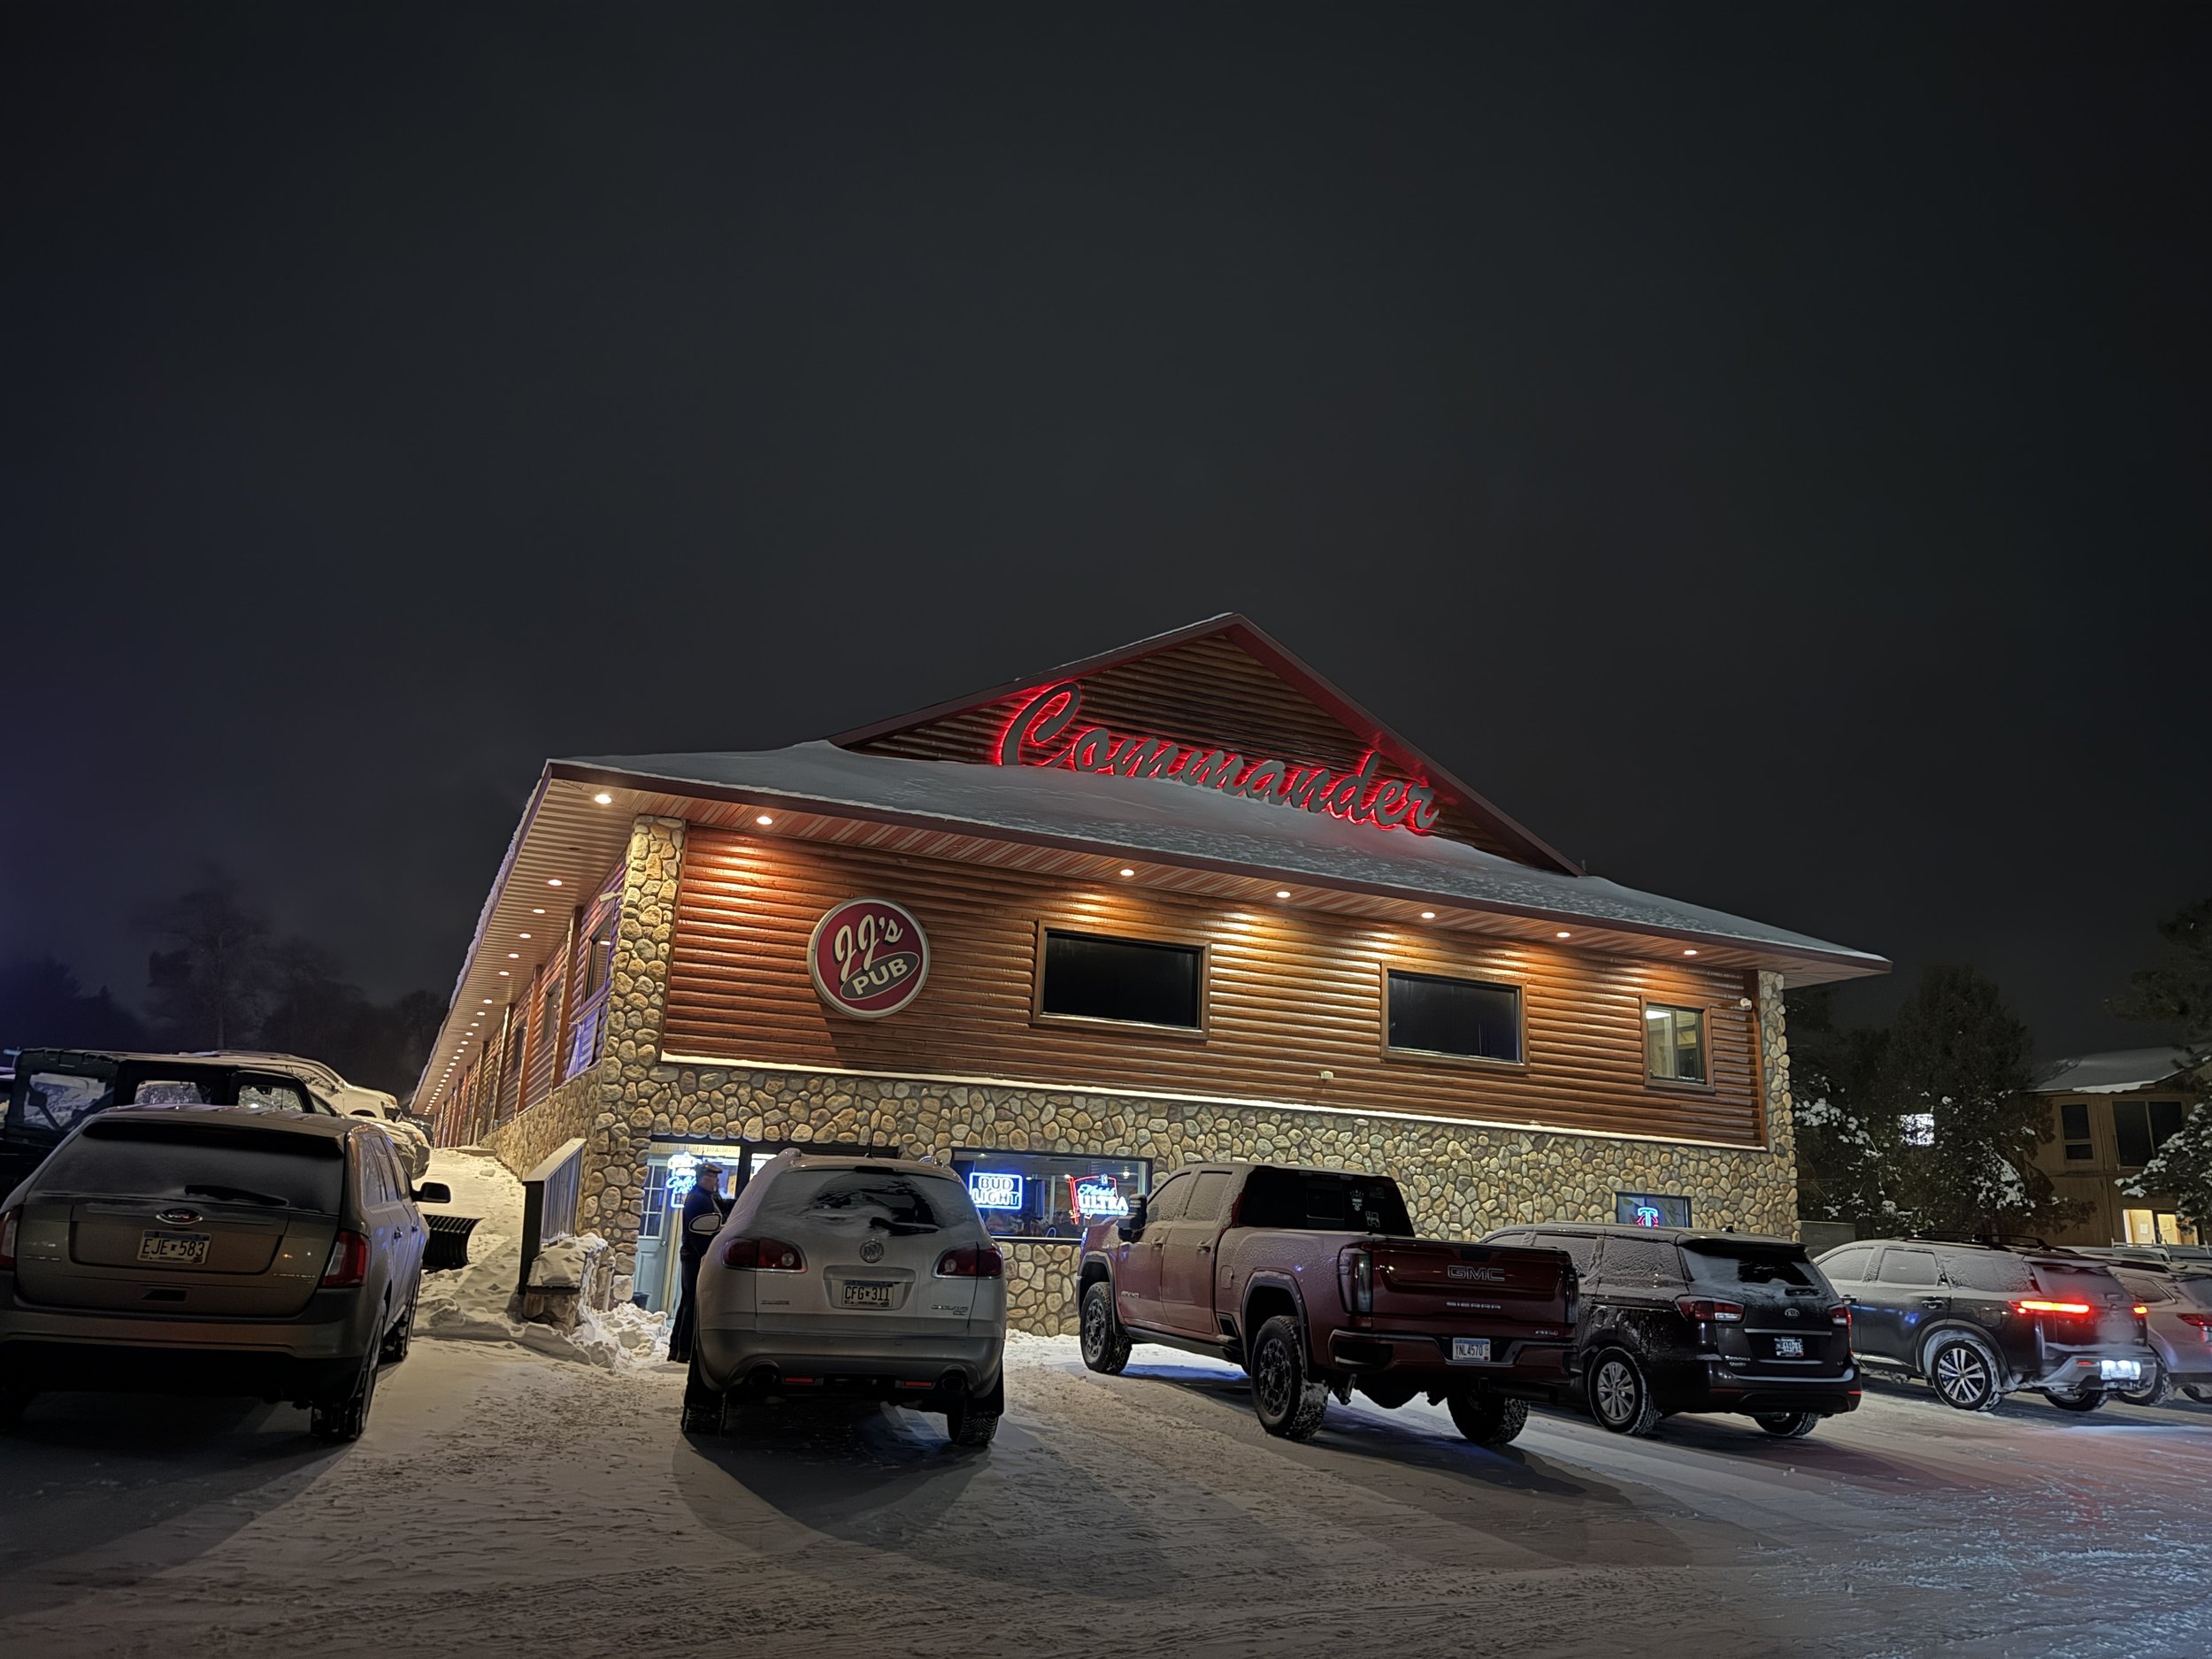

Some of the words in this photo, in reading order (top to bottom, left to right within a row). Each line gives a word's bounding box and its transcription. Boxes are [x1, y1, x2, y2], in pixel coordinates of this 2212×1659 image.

[1001, 682, 1440, 829] Commander
[833, 914, 903, 982] JJ's
[851, 958, 908, 995] PUB
[979, 1176, 1015, 1191] BUD
[972, 1188, 1020, 1206] LIGHT
[1078, 1194, 1130, 1211] ULTRA
[142, 1238, 171, 1256] EJE
[178, 1240, 205, 1257] 583
[1448, 1265, 1506, 1281] GMC
[844, 1286, 864, 1301] CFG
[871, 1287, 890, 1302] 311
[1455, 1344, 1484, 1356] YNL4570
